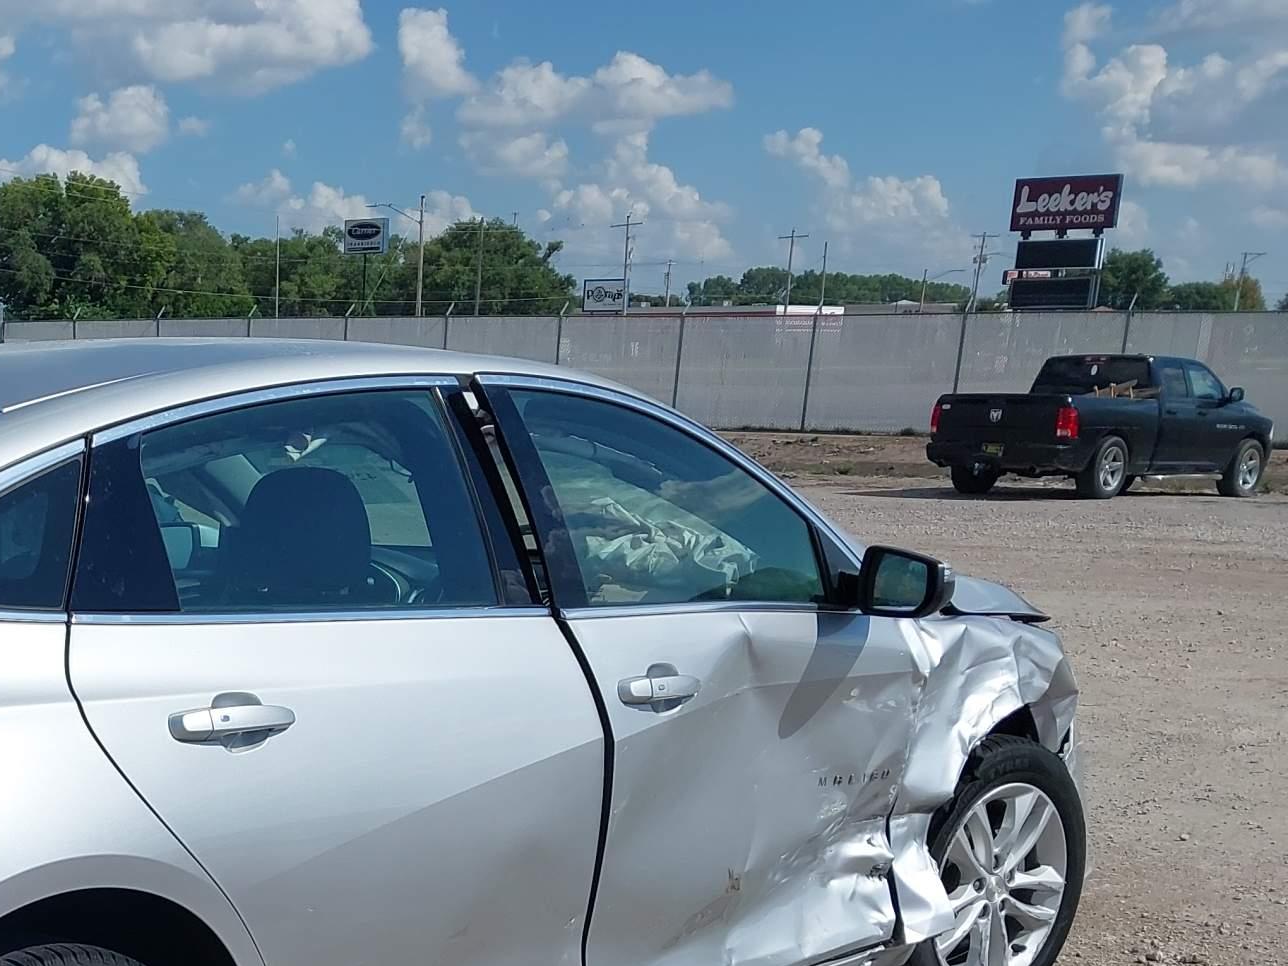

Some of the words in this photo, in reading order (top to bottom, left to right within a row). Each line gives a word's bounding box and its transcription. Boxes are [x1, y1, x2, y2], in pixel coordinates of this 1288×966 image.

[1016, 184, 1113, 213] Leeker's
[1019, 215, 1063, 226] FAMILY
[1065, 214, 1105, 223] FOODS
